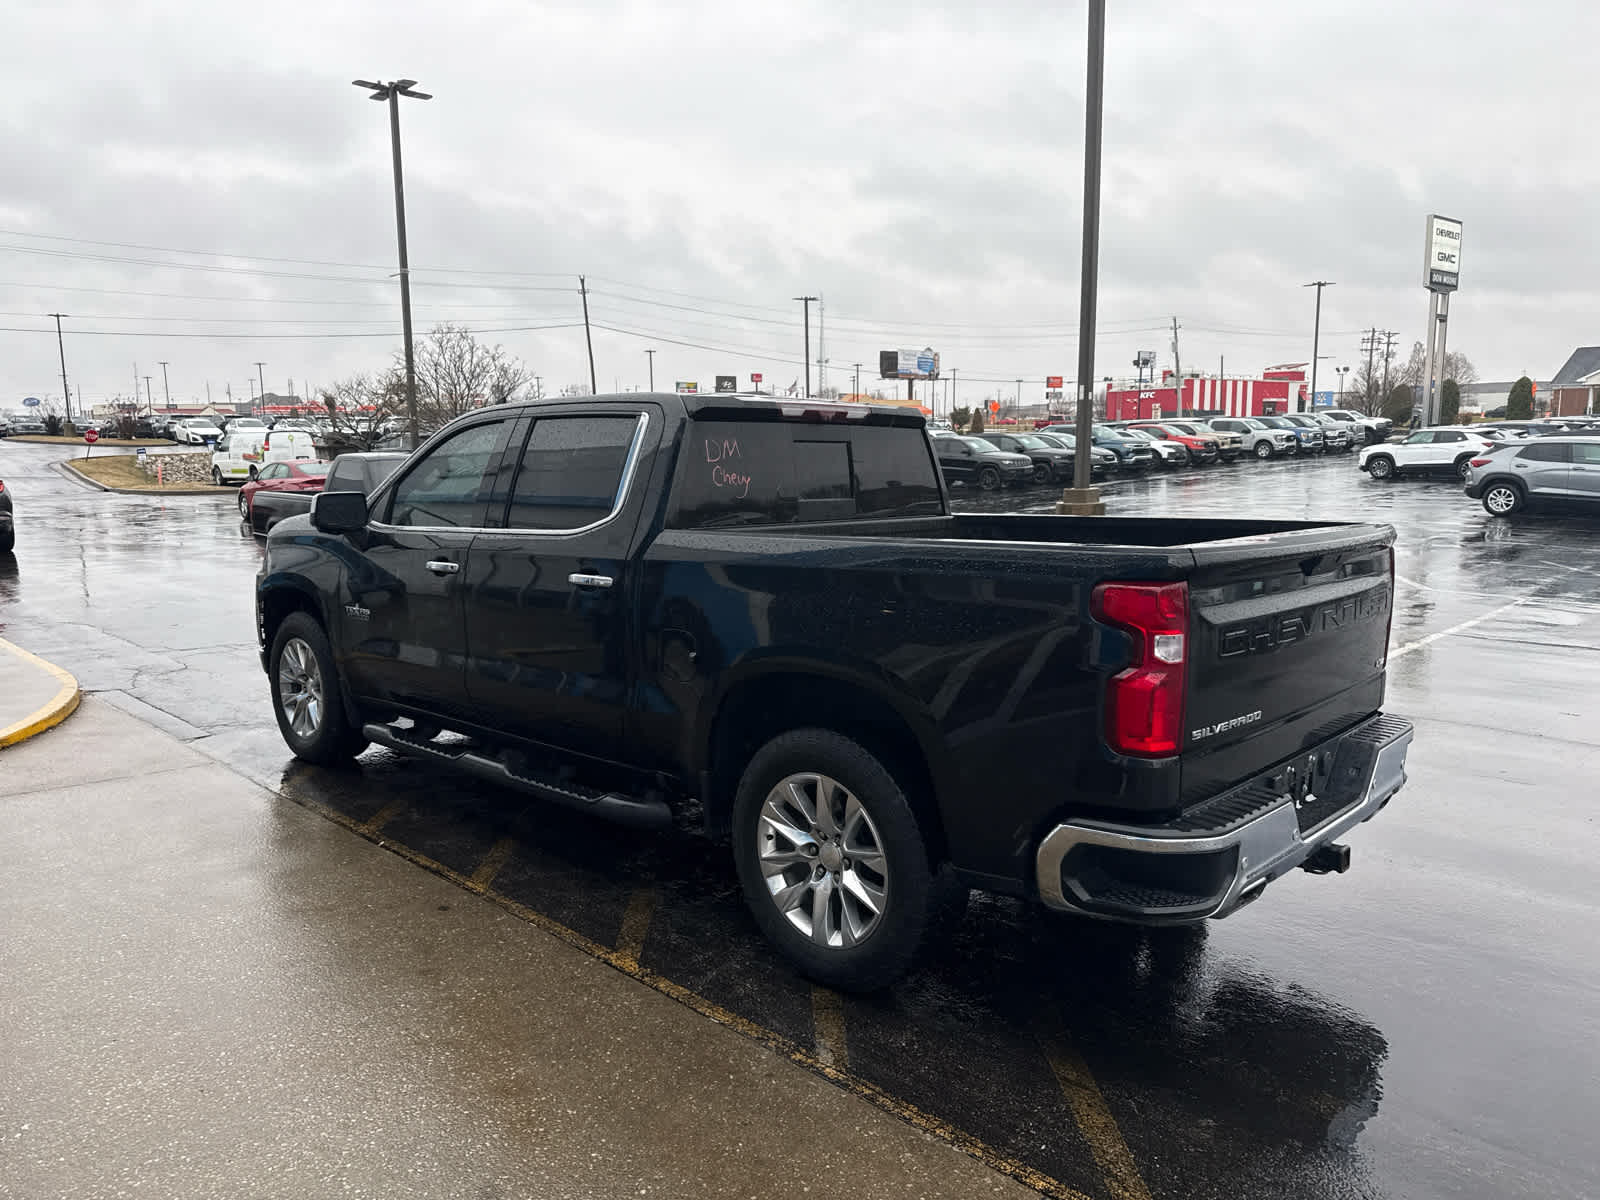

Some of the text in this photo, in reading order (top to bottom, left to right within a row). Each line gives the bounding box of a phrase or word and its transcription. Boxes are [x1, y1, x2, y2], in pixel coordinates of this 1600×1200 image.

[1436, 227, 1461, 240] CHEVROLET
[1437, 251, 1456, 264] GMC
[1140, 391, 1155, 399] KFC
[704, 438, 741, 462] DM
[712, 465, 752, 499] Chevy
[1191, 709, 1262, 741] SILVERADO
